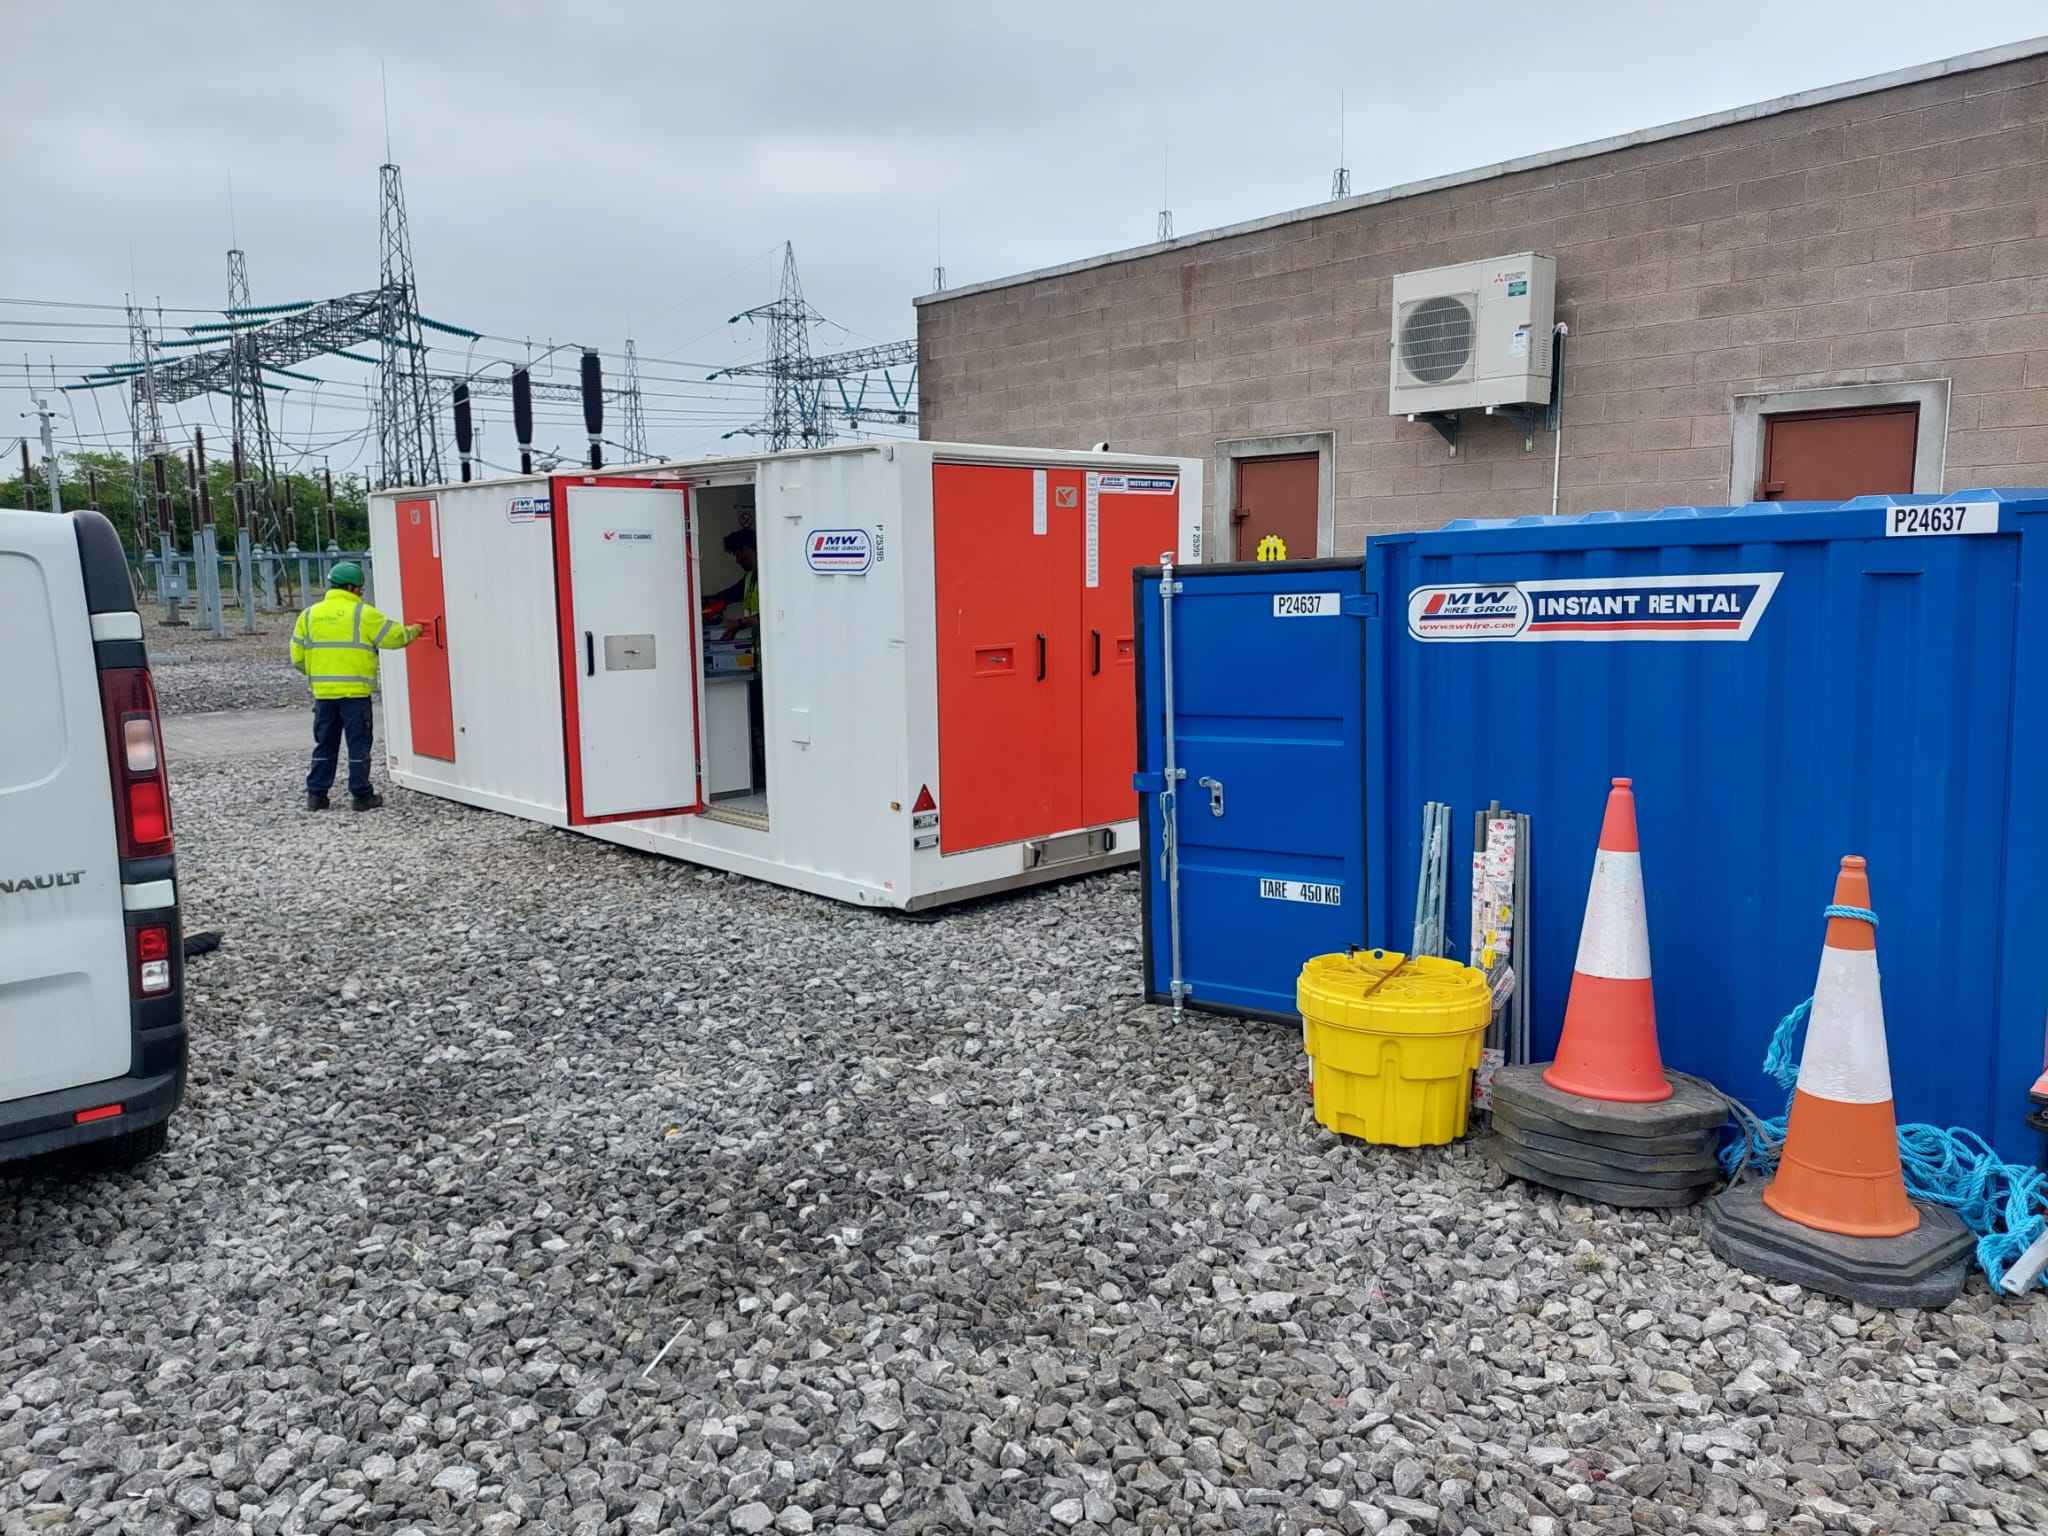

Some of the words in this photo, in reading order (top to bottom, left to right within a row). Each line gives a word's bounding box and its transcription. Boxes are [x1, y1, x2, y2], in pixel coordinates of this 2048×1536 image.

[1152, 480, 1171, 488] RENTAL
[1088, 476, 1097, 533] DRYING
[1894, 507, 1967, 533] P24637
[825, 536, 858, 545] MW
[876, 534, 885, 562] 25395
[1088, 539, 1097, 582] ROOM
[1278, 596, 1321, 614] P24637
[1444, 605, 1470, 614] HIRE
[1474, 605, 1518, 614] GROUP
[1447, 591, 1510, 605] MW
[1538, 595, 1640, 616] INSTANT
[1649, 593, 1741, 614] RENTAL
[0, 869, 86, 893] NAULT
[1262, 880, 1288, 899] TARE
[1300, 884, 1322, 902] 450
[1325, 886, 1339, 904] KG
